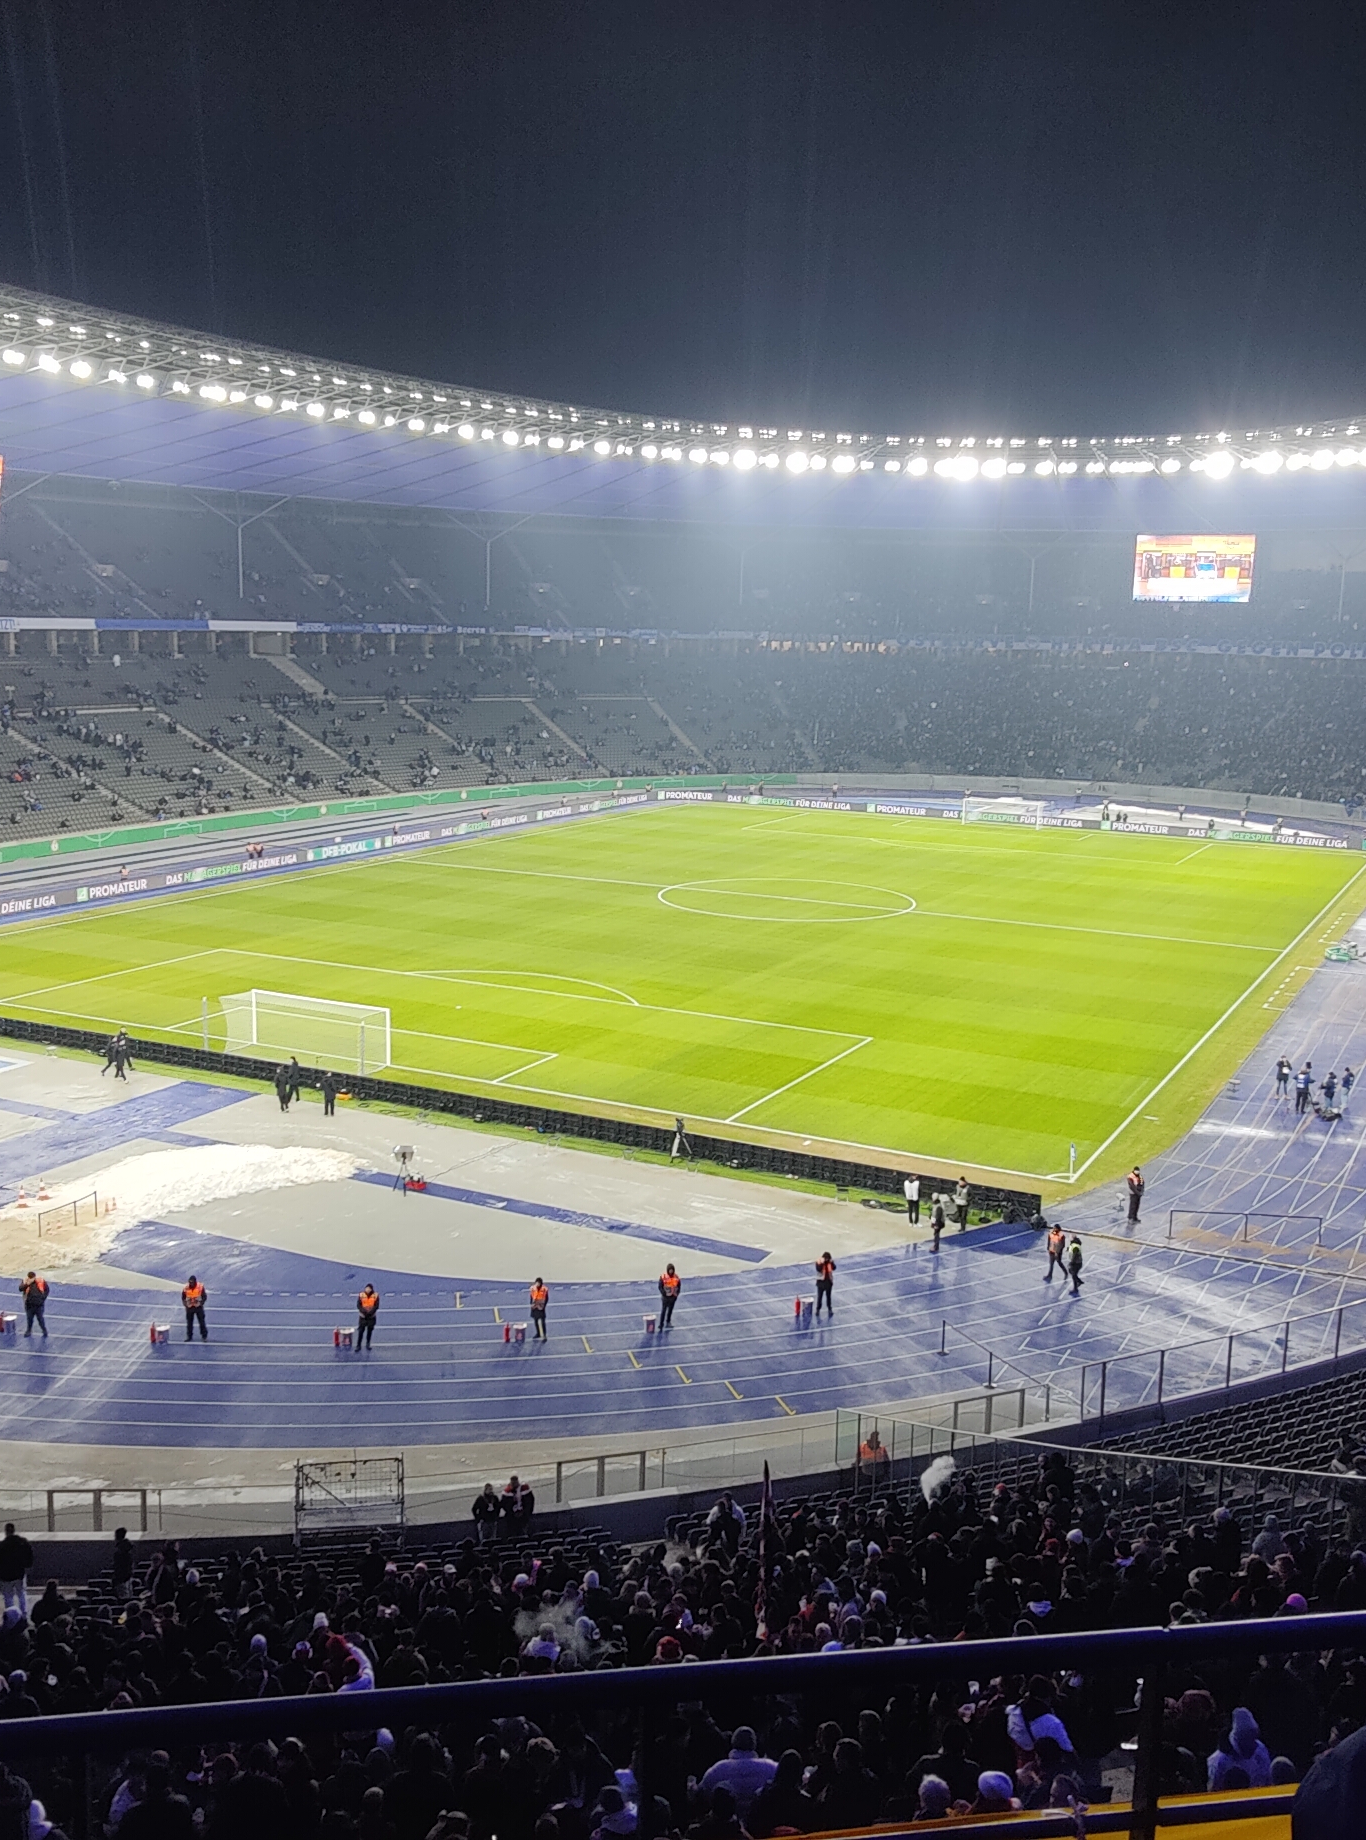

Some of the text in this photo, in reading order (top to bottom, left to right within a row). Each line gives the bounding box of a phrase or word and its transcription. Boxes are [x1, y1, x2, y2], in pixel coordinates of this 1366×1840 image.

[896, 632, 1014, 649] OSTKURVE
[1154, 637, 1201, 651] BSC
[1216, 638, 1301, 656] GEGEN
[666, 790, 713, 801] PROMATEUR
[727, 794, 741, 803] DAS
[795, 797, 810, 808] FÜR
[811, 799, 834, 810] DEINE
[834, 801, 851, 811] LIGA
[876, 804, 926, 816] PROMATEUR
[942, 809, 959, 819] DAS
[1019, 813, 1036, 824] FÜR
[1037, 816, 1063, 827] DEINE
[1063, 818, 1083, 828] LIGA
[1112, 822, 1169, 835] PROMATEUR
[393, 830, 431, 845] PROMATEUR
[1187, 827, 1348, 849] DAS MAAGERSPIEL FÜR DEINE LIGA
[322, 841, 367, 859] DFB-POKAL
[165, 853, 297, 885] DAS MAAGERSPIEL FÜR DEINE LIGA
[89, 878, 147, 899] PROMATEUR
[1, 898, 32, 915] DEINE
[33, 894, 56, 909] LIGA
